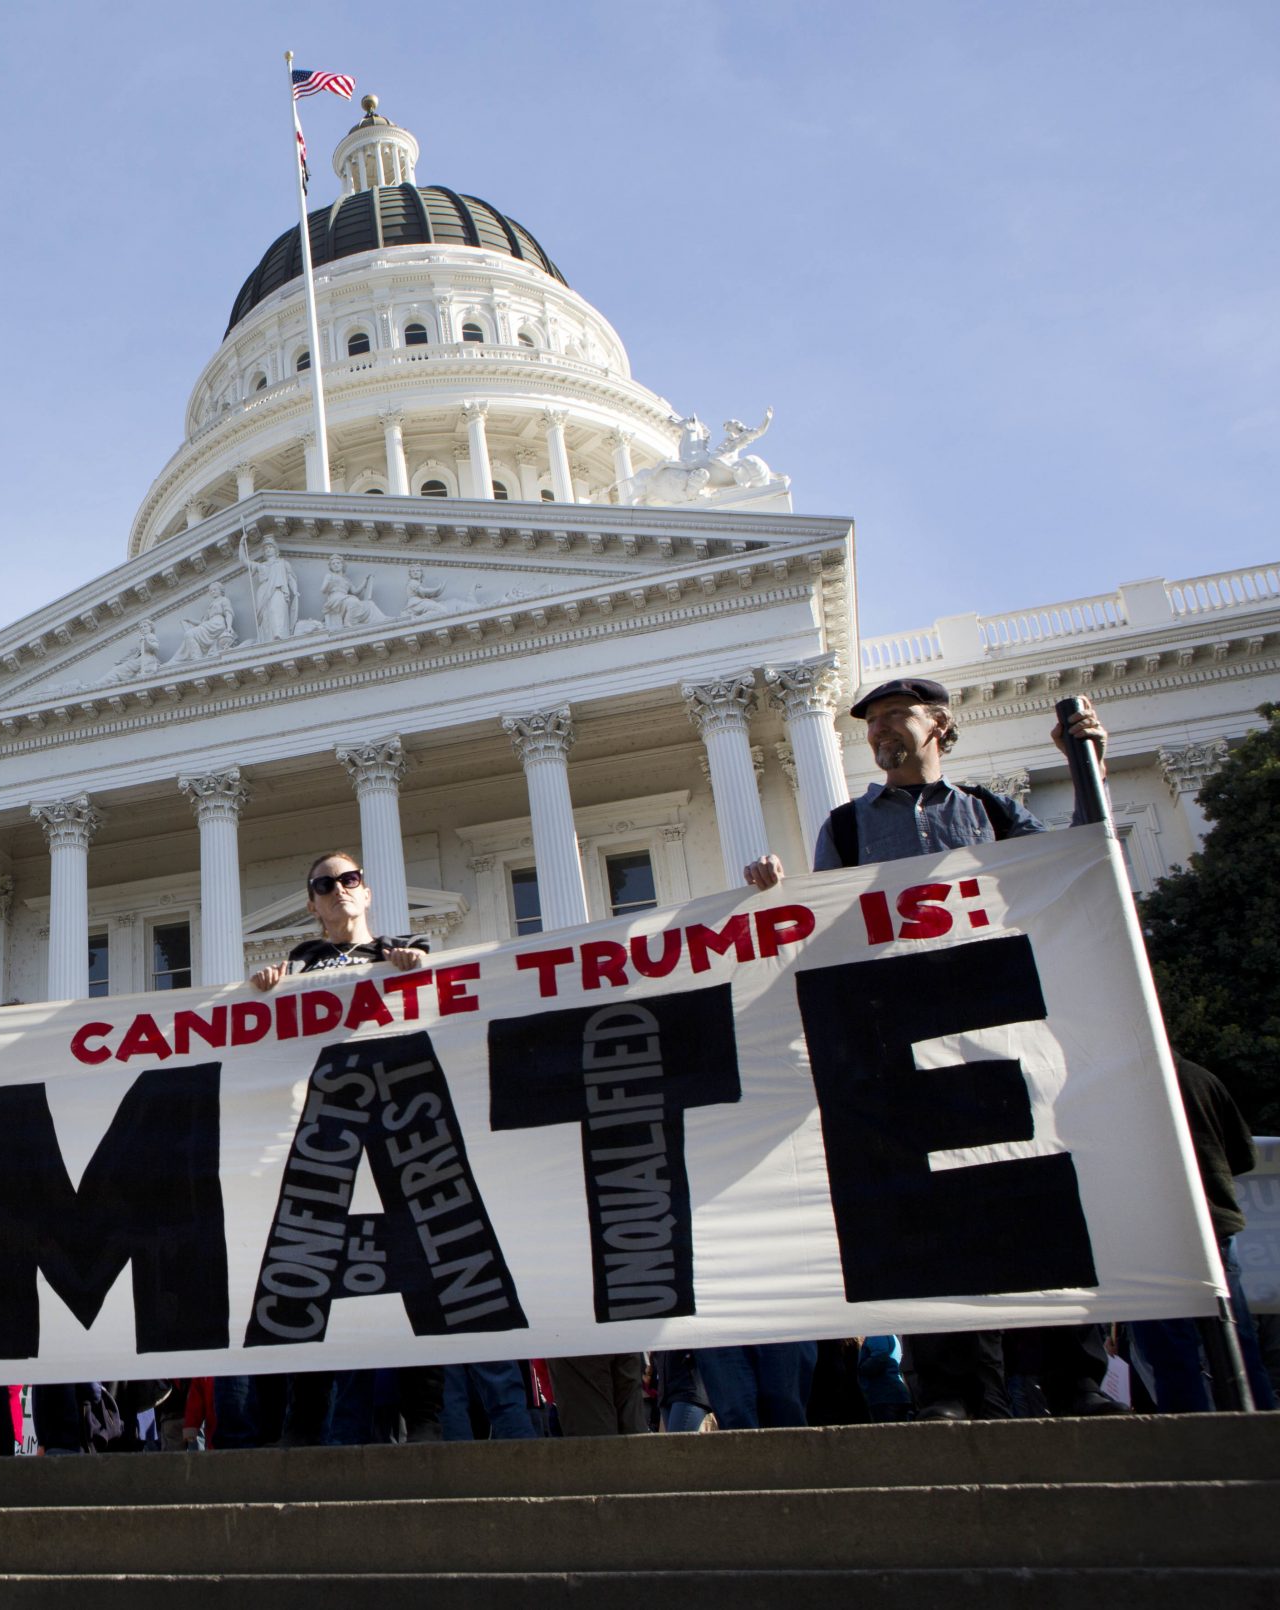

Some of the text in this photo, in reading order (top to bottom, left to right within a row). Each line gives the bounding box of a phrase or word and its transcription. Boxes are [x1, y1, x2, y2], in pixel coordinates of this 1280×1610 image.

[70, 879, 990, 1065] CANDIDATE TRUMP IS:
[373, 1060, 510, 1326] INTEREST
[582, 1002, 678, 1321] UNQUALIFIED
